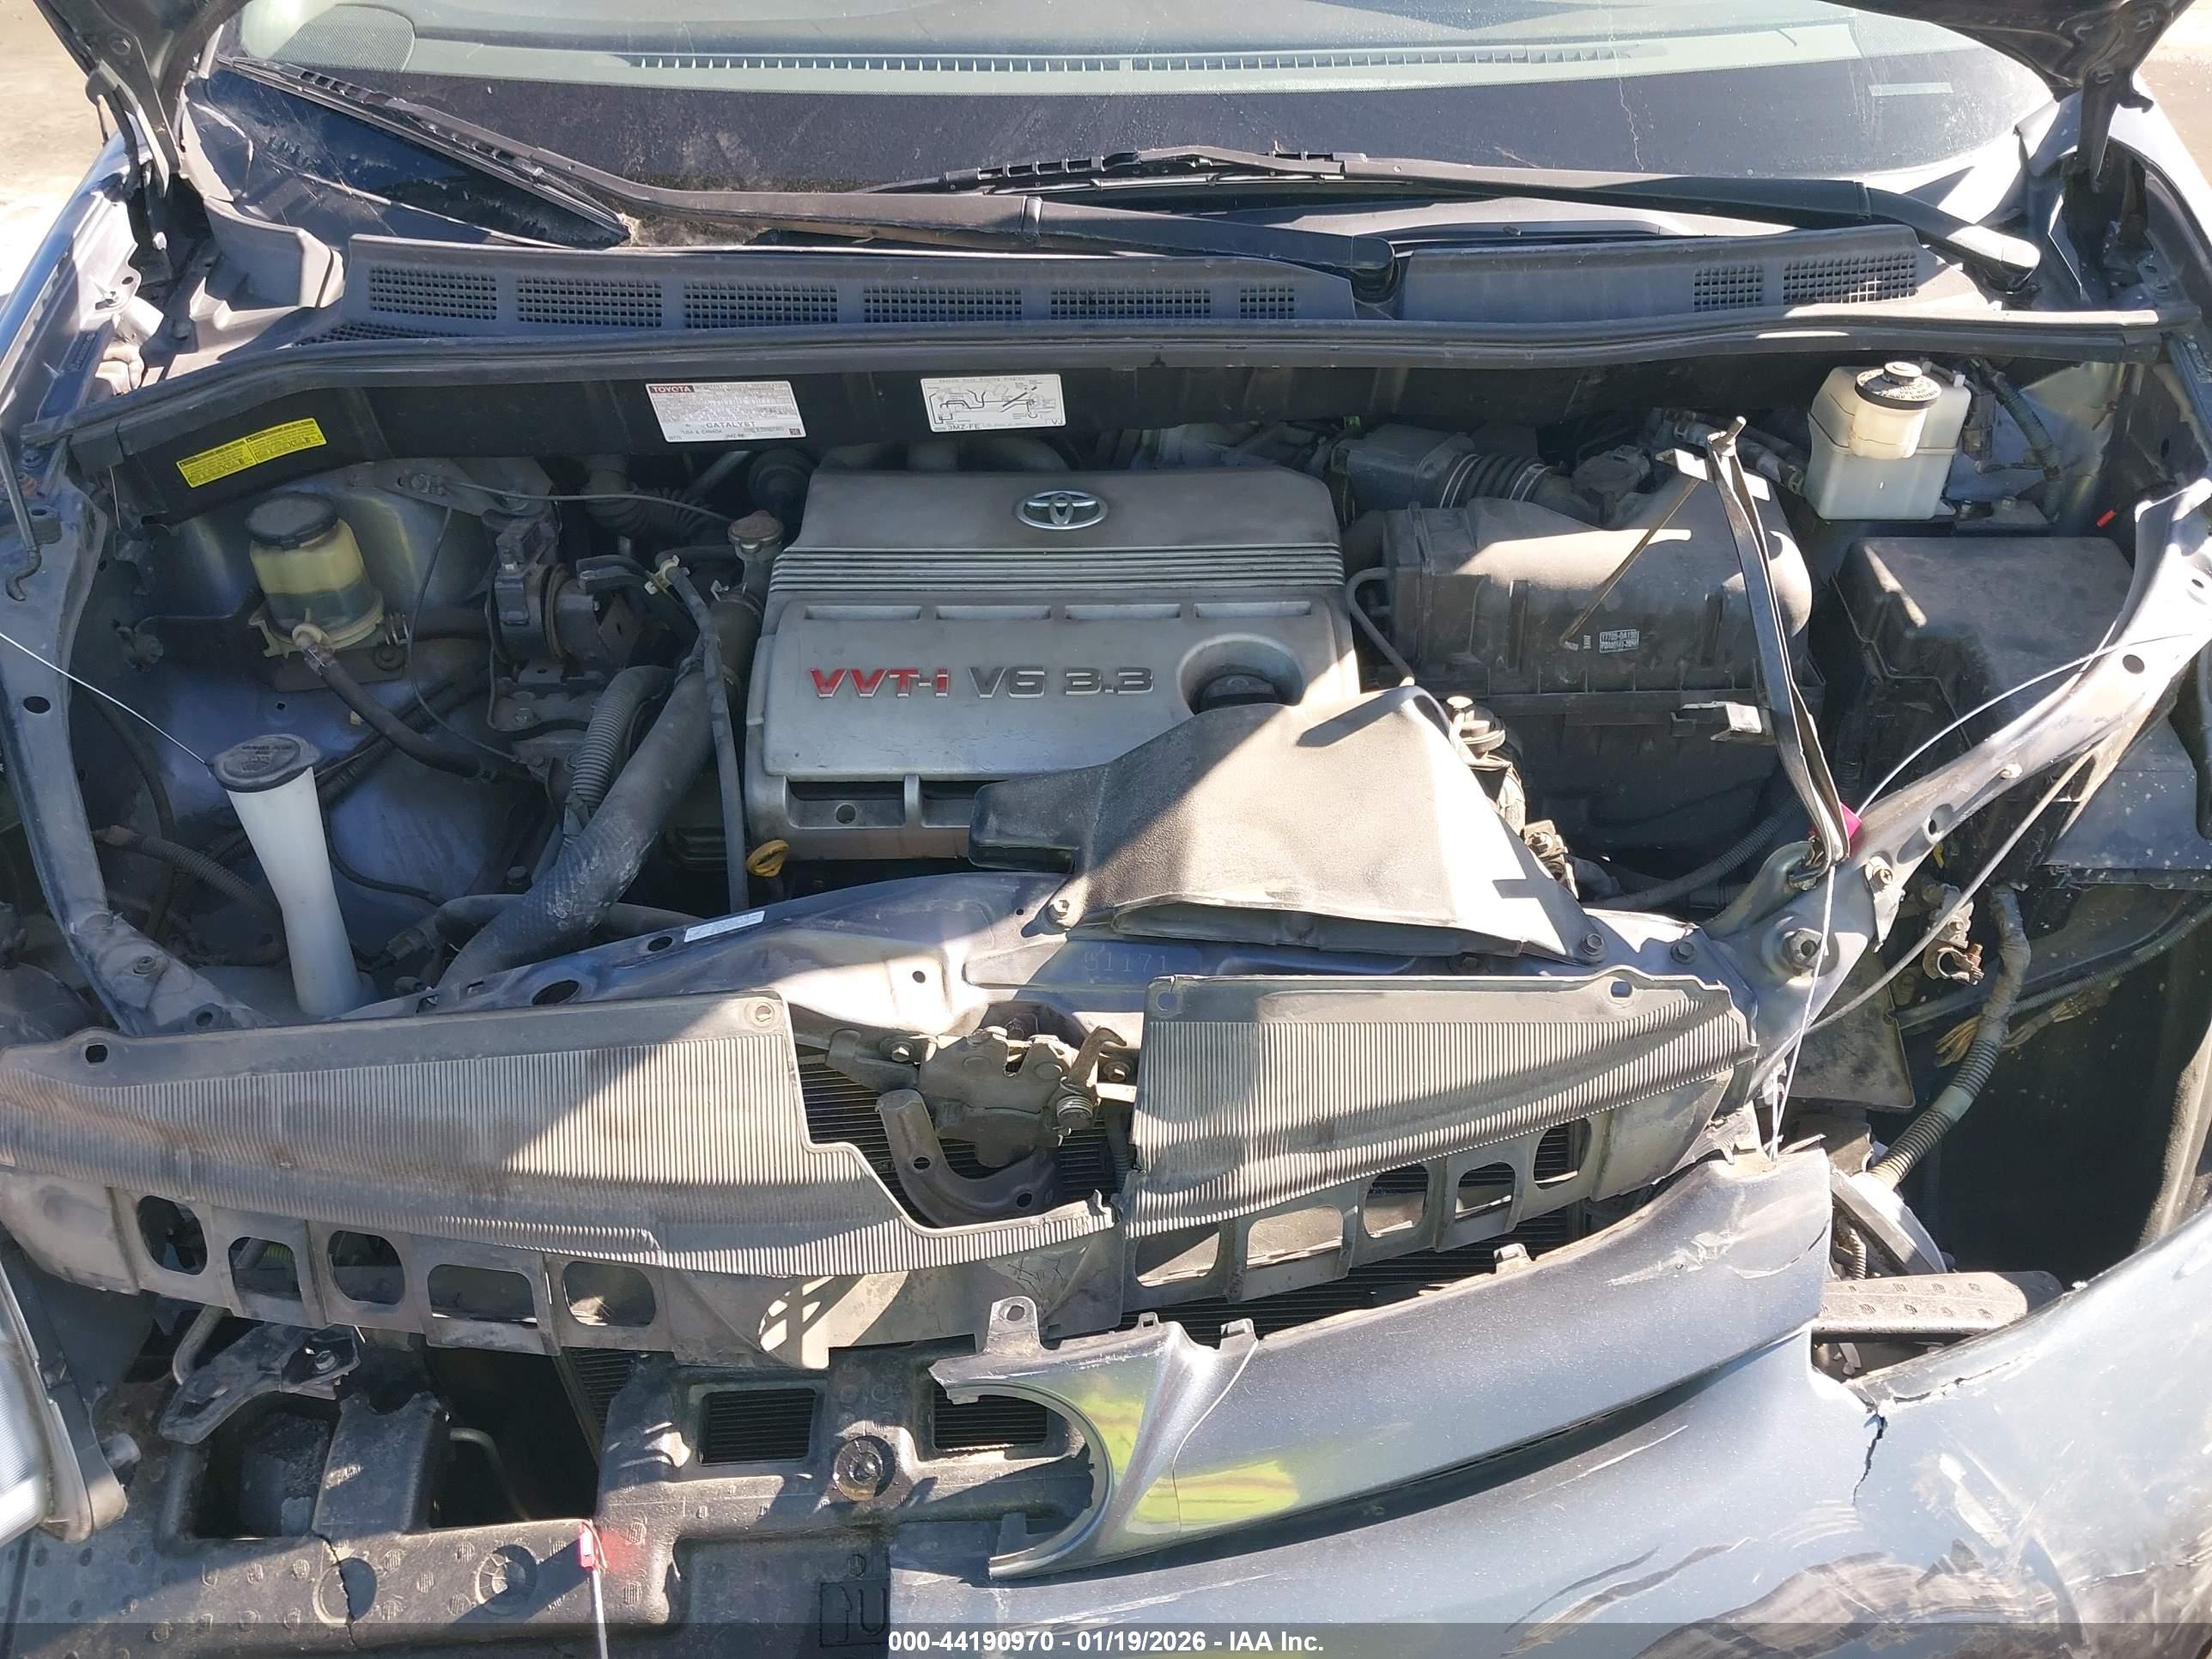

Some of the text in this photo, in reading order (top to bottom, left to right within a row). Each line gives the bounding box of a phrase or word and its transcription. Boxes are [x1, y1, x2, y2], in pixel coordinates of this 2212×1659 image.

[810, 665, 1155, 699] VVT-i V6 3.3
